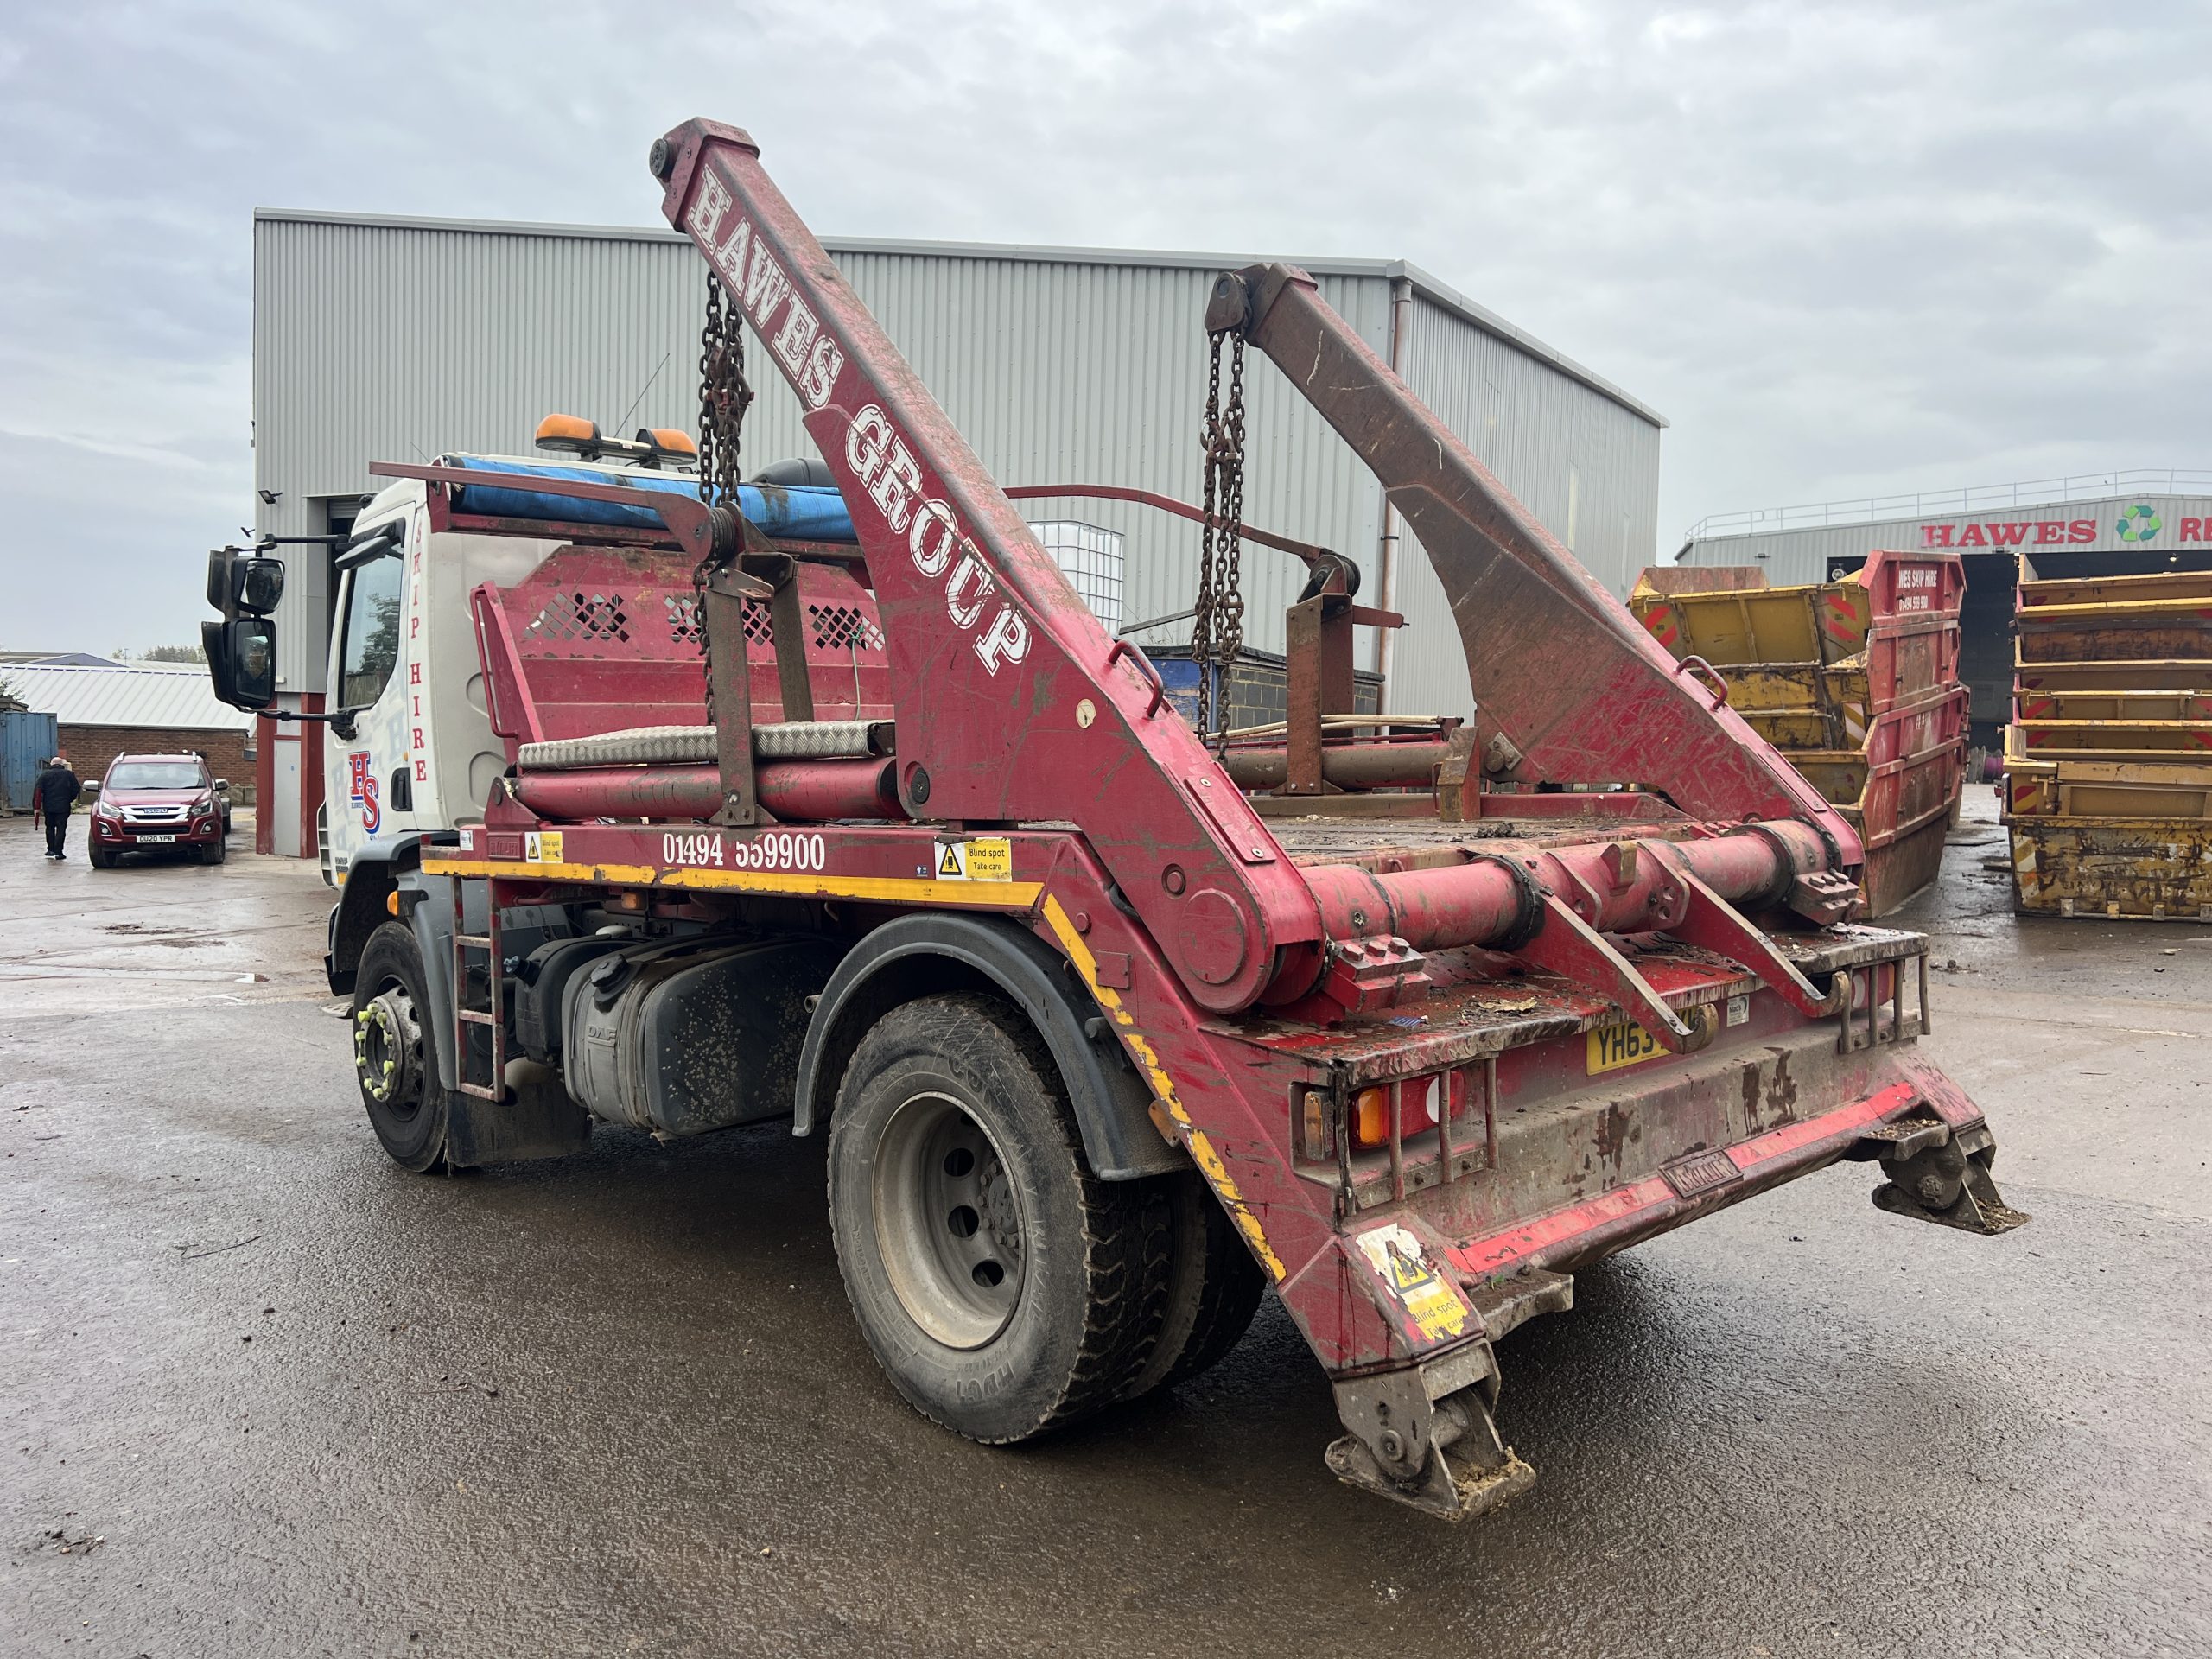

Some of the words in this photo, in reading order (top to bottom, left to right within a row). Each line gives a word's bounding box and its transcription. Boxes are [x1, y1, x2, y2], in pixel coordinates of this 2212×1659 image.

[687, 164, 845, 410] HAWES
[844, 403, 1033, 677] GROUP
[1921, 519, 2097, 549] HAWES
[410, 521, 422, 639] SKIP
[410, 663, 427, 781] HIRE
[663, 833, 723, 866] 01494
[735, 833, 825, 870] 559900
[969, 848, 986, 857] Blind
[988, 849, 1005, 859] spot
[588, 1025, 617, 1047] DAF
[1412, 1307, 1437, 1324] Blind
[1437, 1299, 1459, 1314] spot
